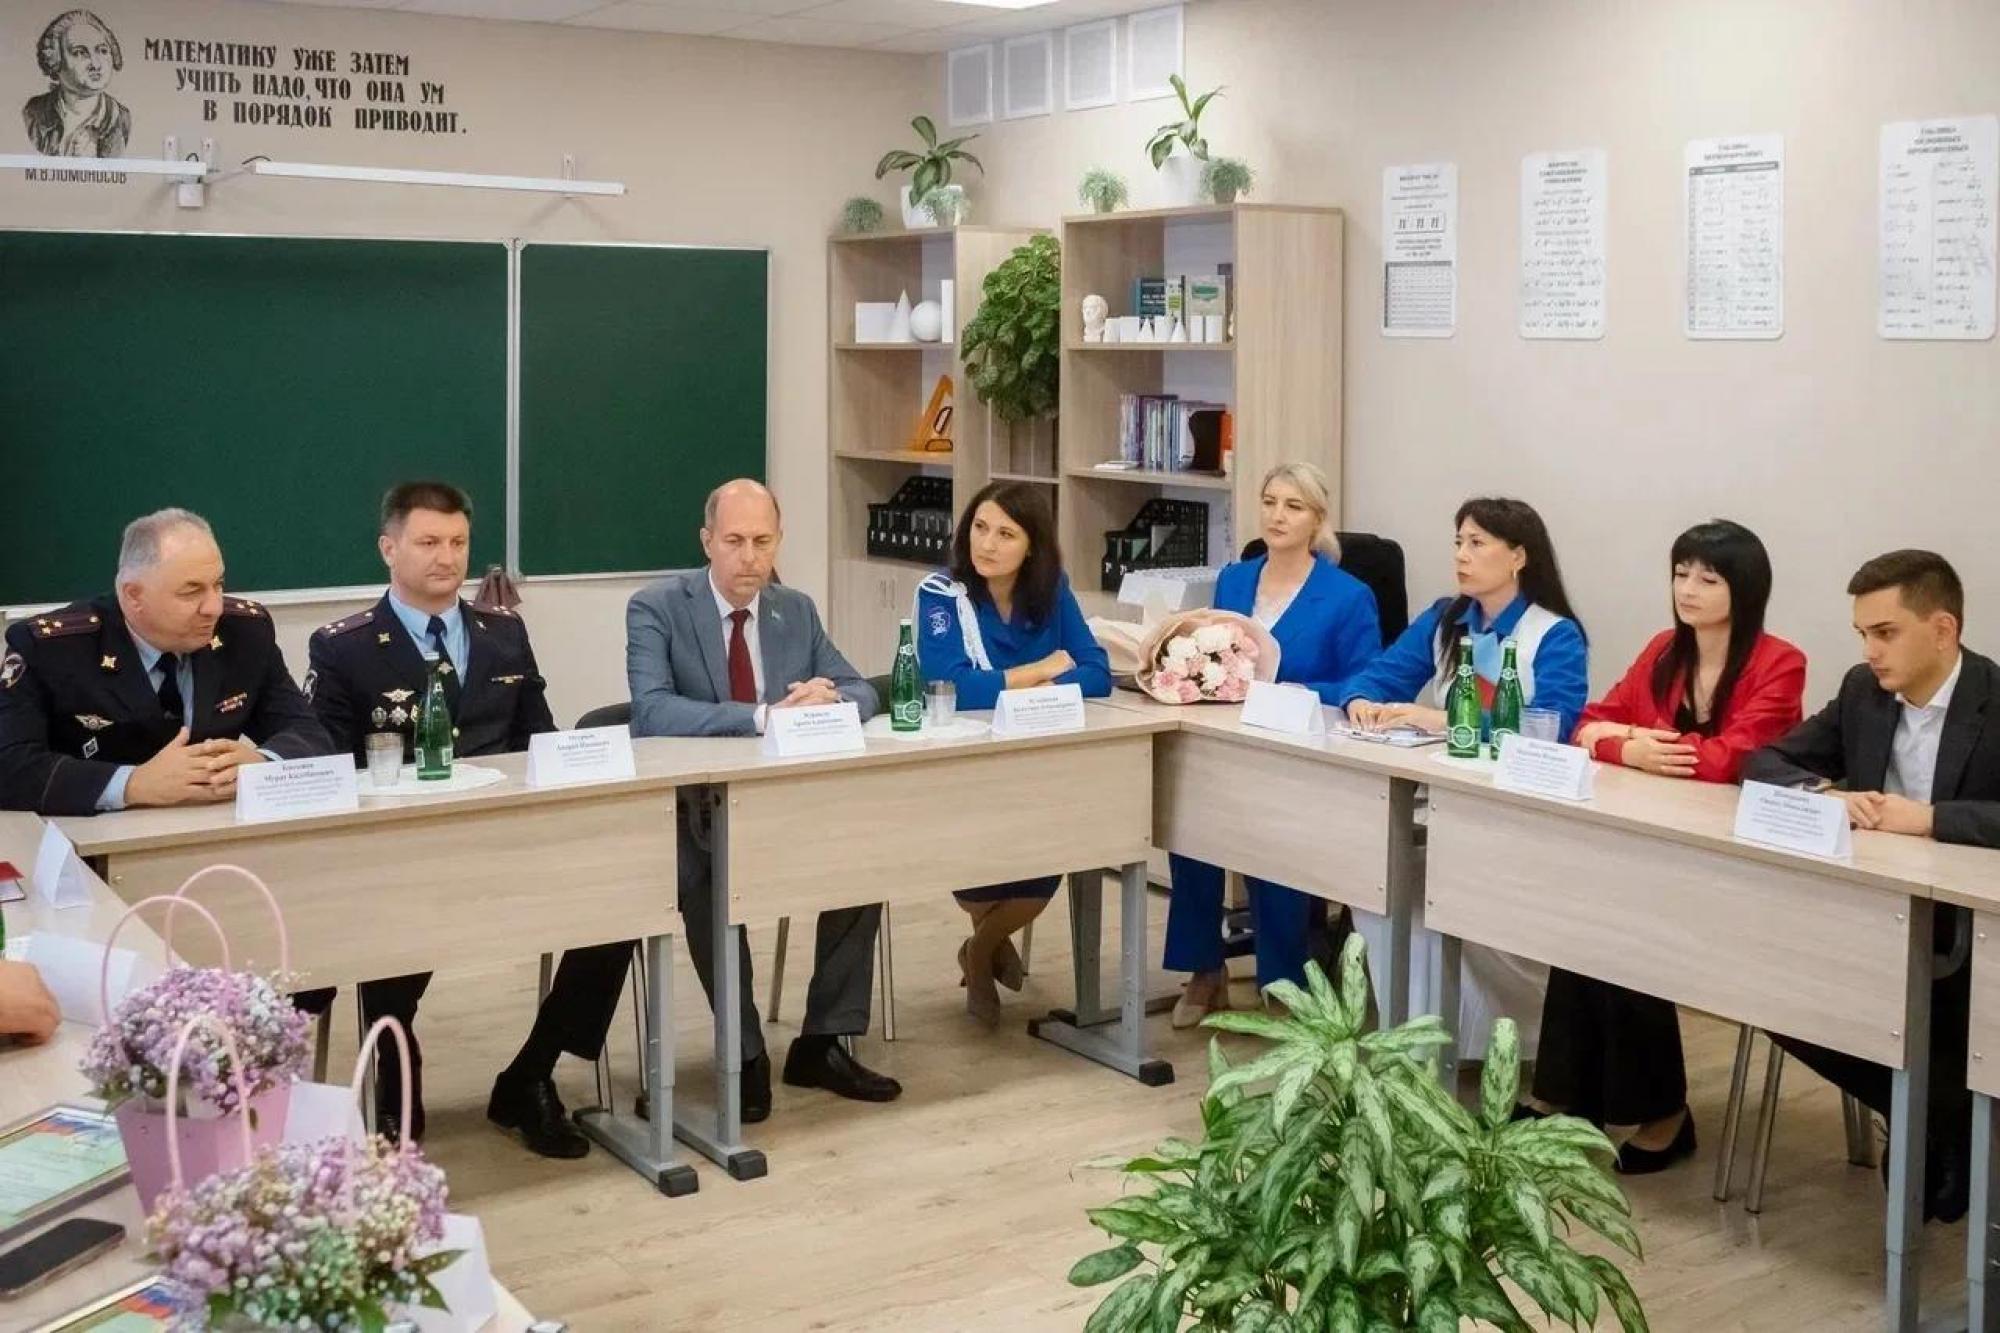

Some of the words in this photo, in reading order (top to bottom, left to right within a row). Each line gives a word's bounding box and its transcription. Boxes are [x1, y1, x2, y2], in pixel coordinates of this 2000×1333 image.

[144, 38, 277, 69] МАТЕМАТИКУ
[293, 47, 337, 73] УЖЕ
[350, 52, 409, 76] ЗАТЕМ
[176, 67, 242, 93] УЧИТЬ
[366, 80, 405, 103] ОНА
[420, 82, 445, 105] УМ
[203, 99, 218, 122] В
[233, 101, 332, 129] ПОРЯДОК
[354, 107, 468, 135] ПРИВОДИТ.
